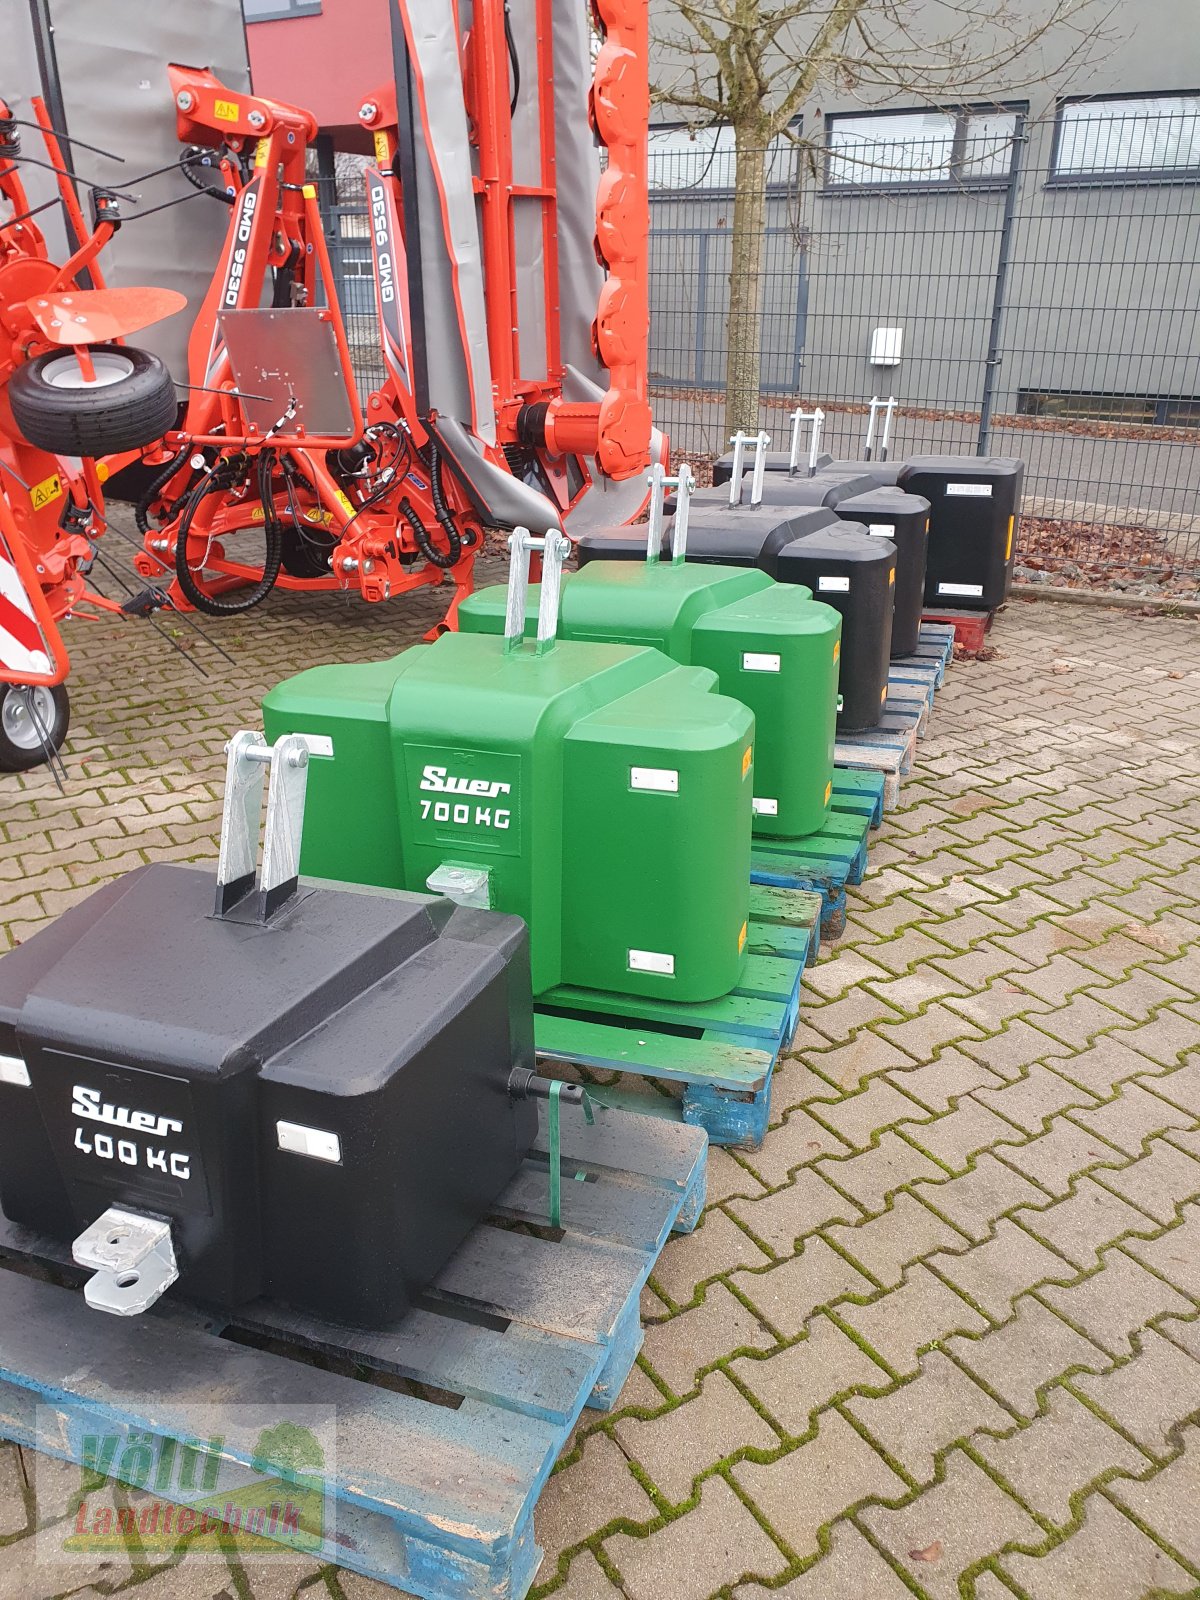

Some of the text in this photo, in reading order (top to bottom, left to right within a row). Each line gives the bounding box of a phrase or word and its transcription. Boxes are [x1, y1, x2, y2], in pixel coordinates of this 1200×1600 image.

[225, 192, 257, 306] GMD 9530
[371, 185, 395, 303] GMD 9530
[419, 765, 511, 798] Suer
[419, 799, 511, 829] 700 KG
[71, 1085, 183, 1137] Suer
[73, 1127, 191, 1180] 400 KG
